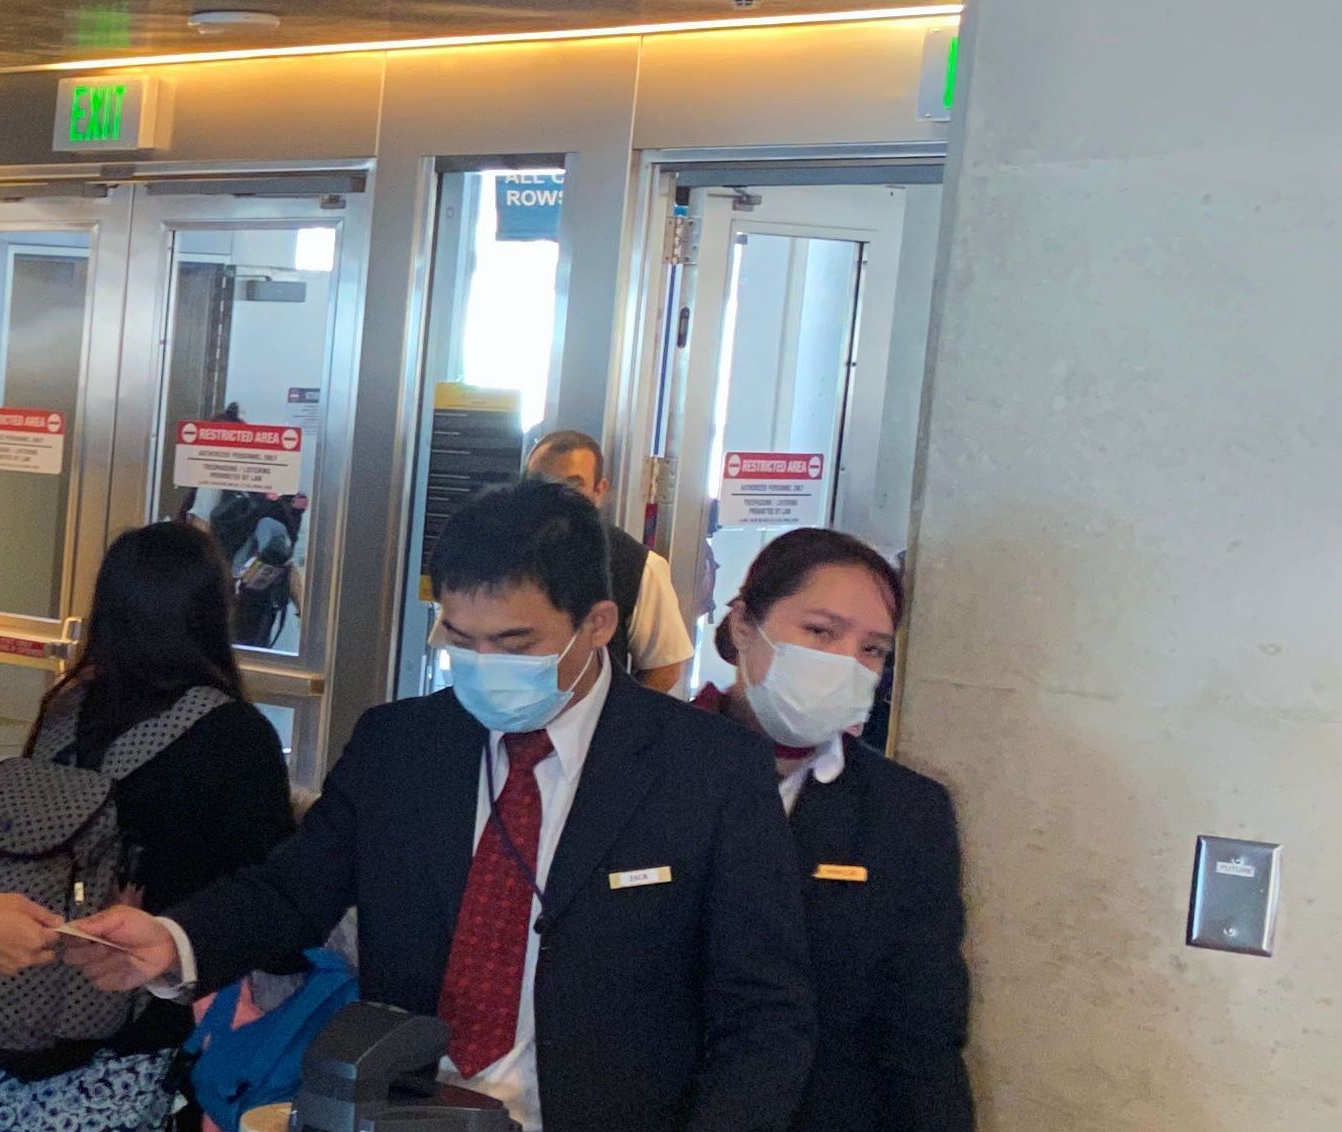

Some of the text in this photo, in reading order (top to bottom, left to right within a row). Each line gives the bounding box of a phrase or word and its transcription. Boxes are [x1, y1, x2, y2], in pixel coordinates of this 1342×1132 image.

[68, 85, 126, 141] EXIT
[25, 415, 46, 428] AREA
[199, 428, 280, 444] RESTRICTED AREA
[741, 459, 807, 473] RESTRICTED AREA
